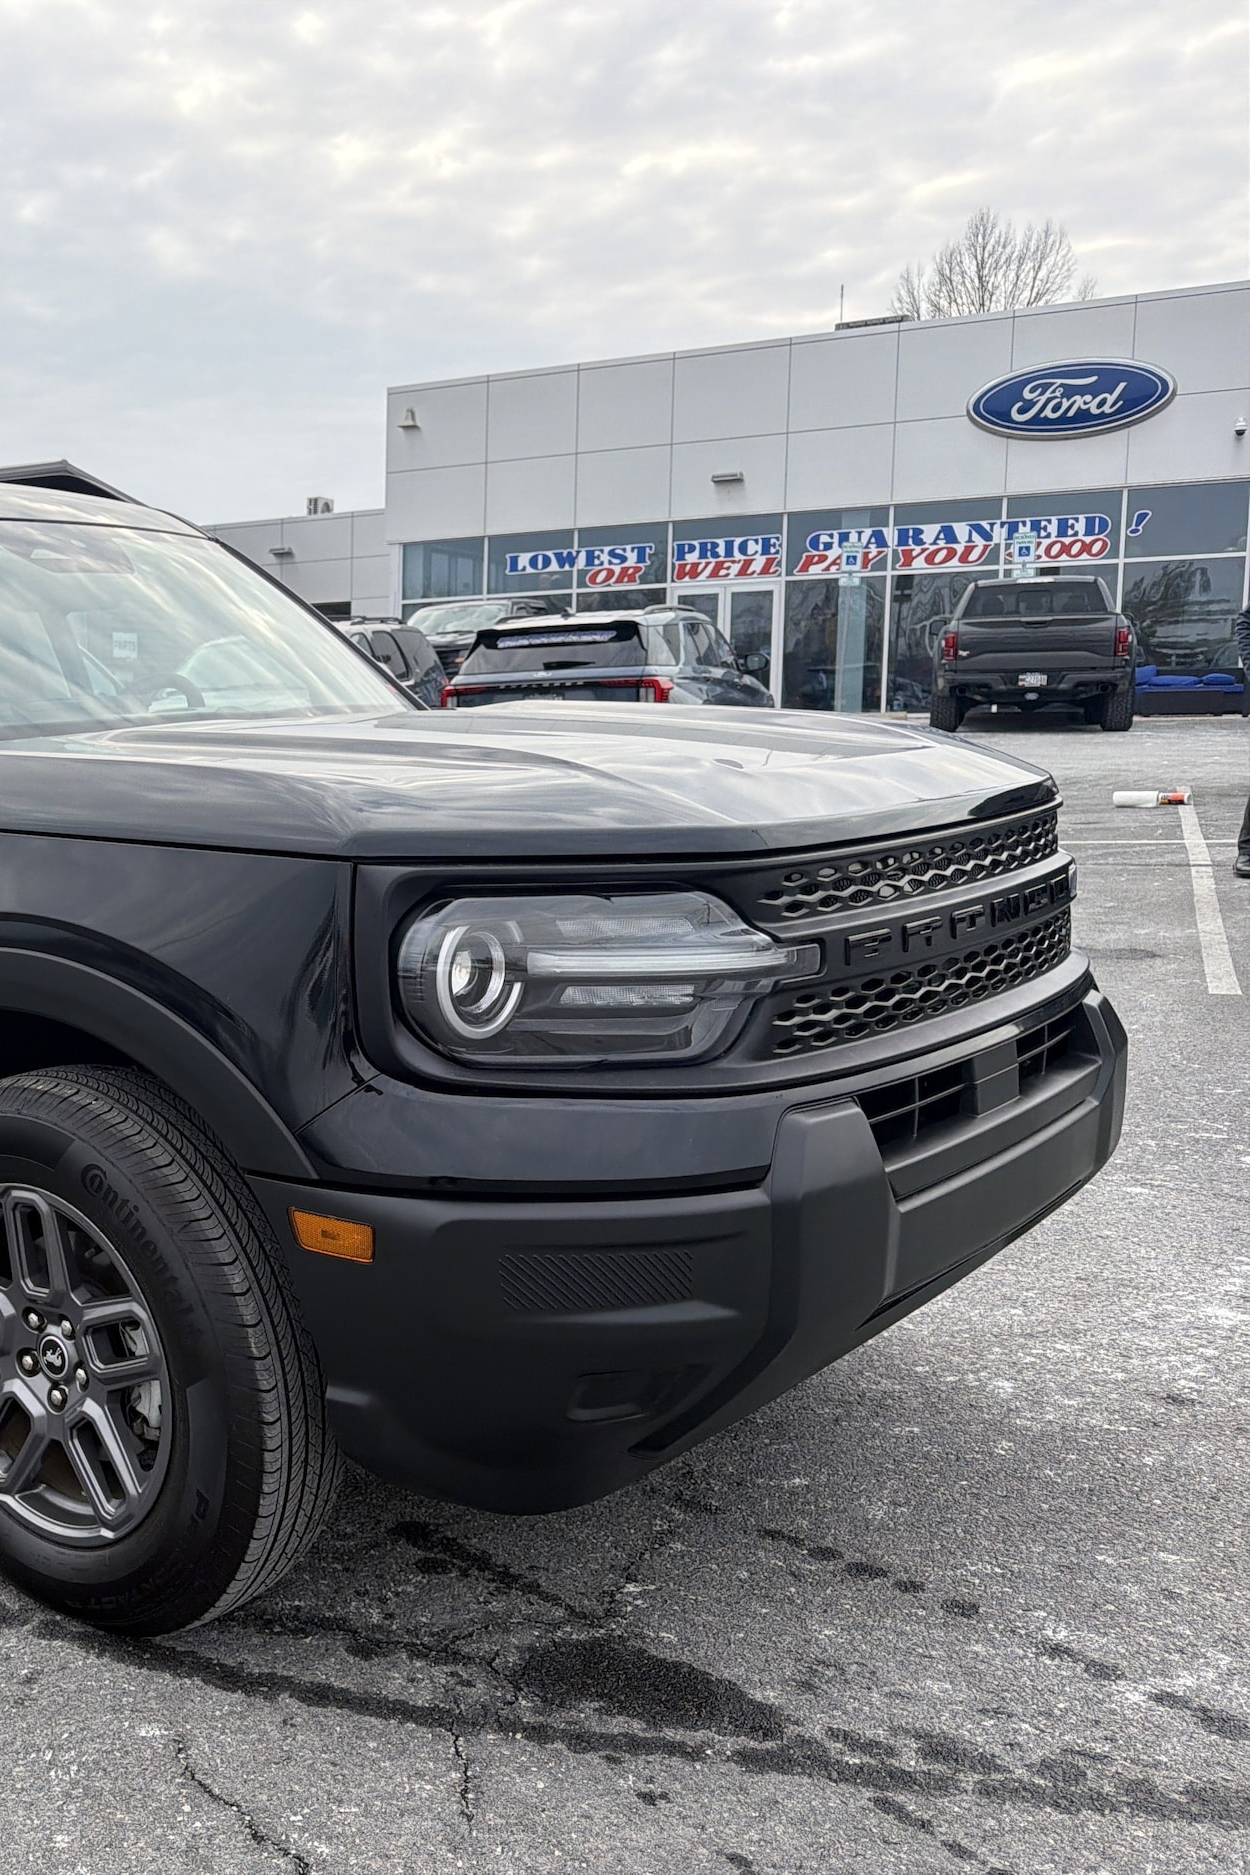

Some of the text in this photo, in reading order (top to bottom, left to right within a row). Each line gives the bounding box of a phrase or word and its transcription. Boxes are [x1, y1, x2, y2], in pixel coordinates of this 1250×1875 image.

[1010, 375, 1128, 423] Ford
[507, 544, 654, 574] LOWEST
[673, 535, 781, 562] PRICE
[806, 514, 1111, 553] GUARANTEED
[587, 564, 644, 586] OR
[897, 543, 991, 568] YOU
